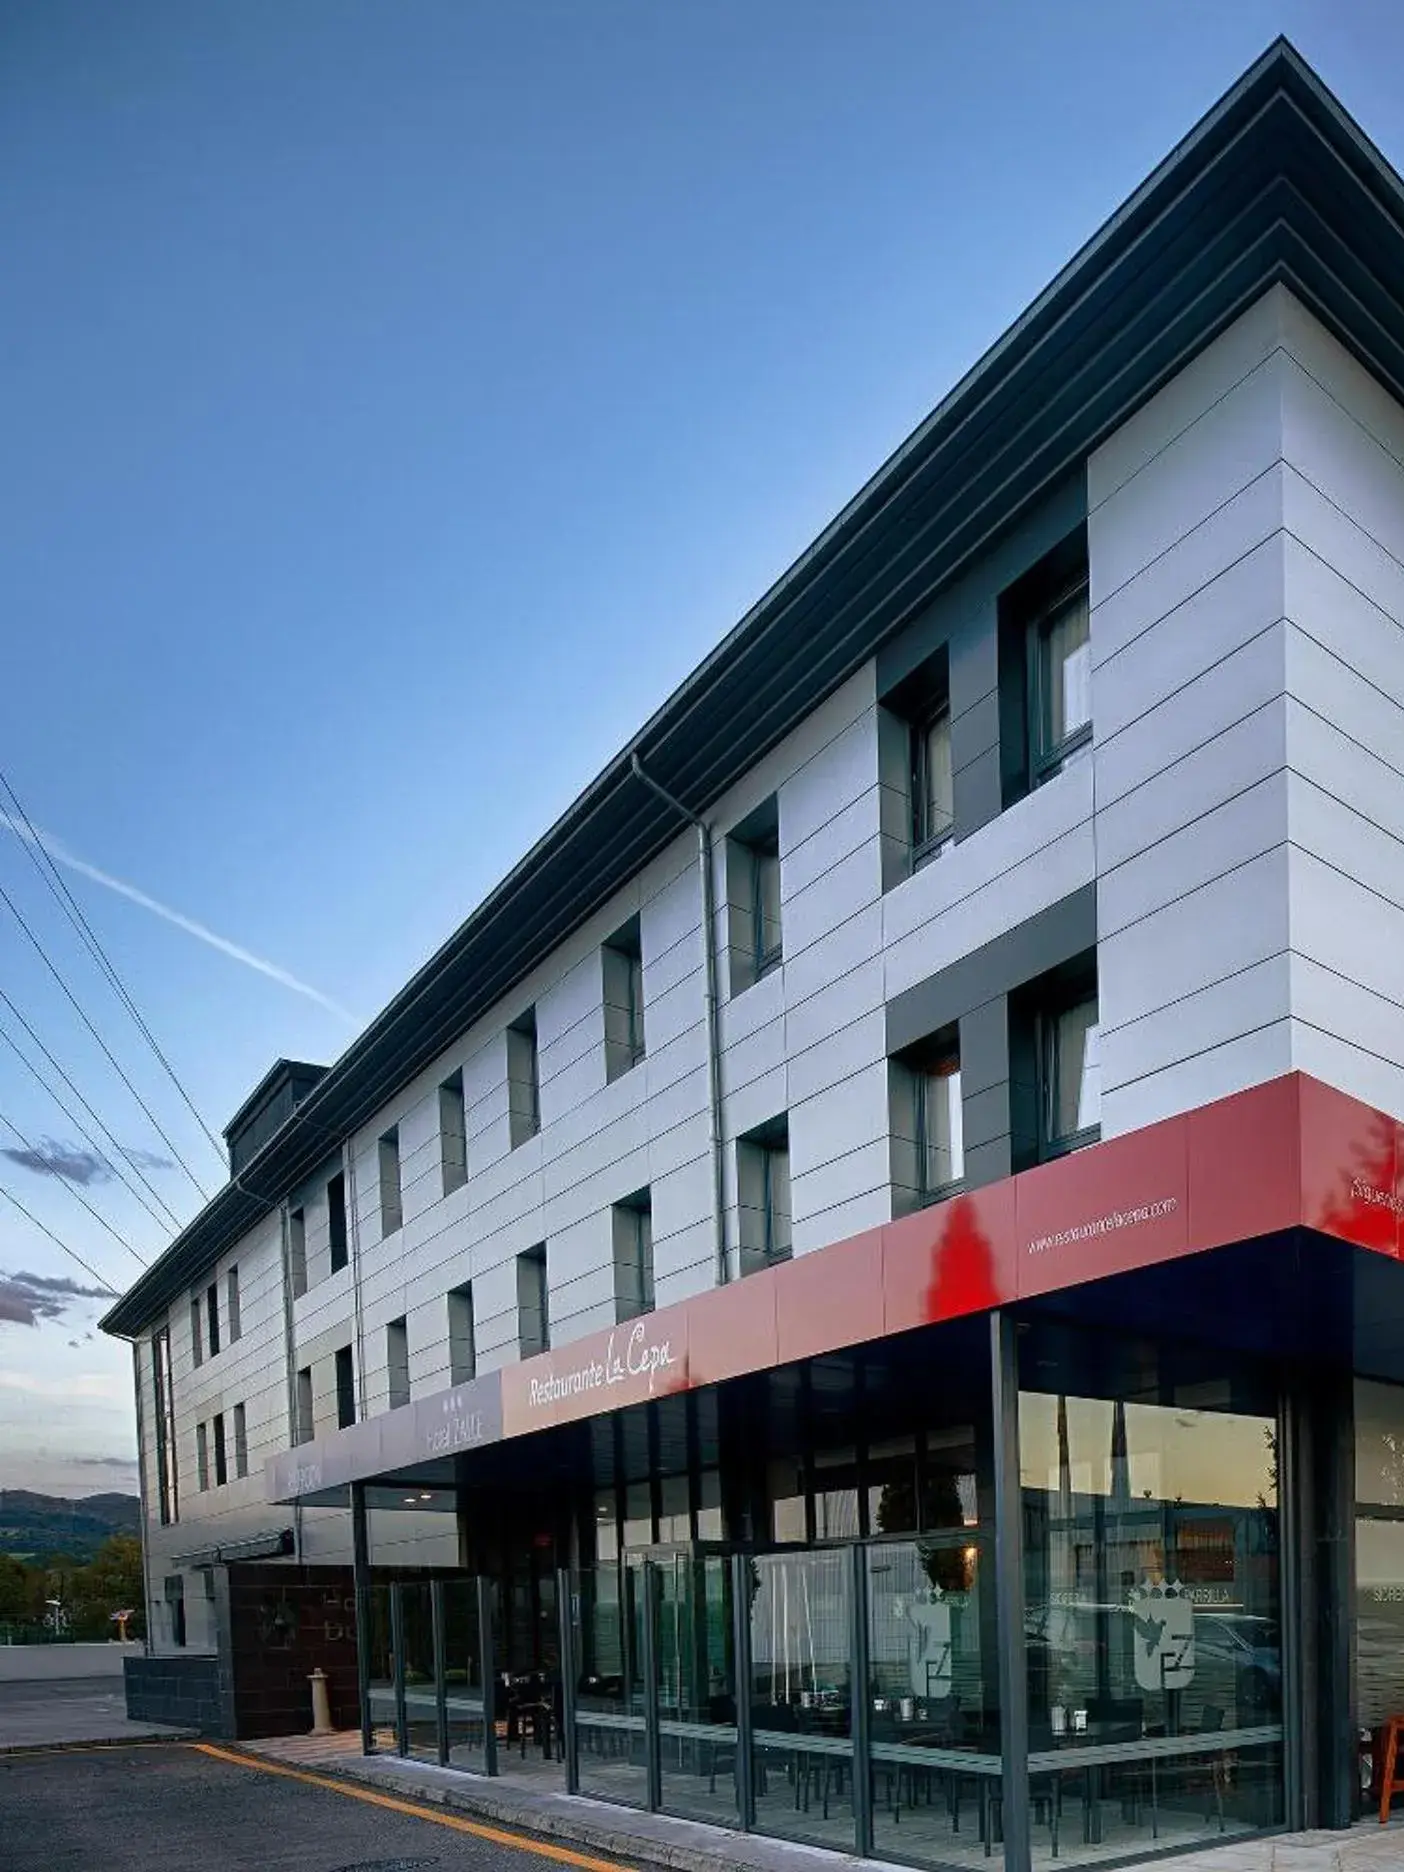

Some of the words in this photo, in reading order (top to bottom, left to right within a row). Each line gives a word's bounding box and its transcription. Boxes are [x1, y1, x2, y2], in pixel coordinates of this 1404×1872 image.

[529, 1359, 603, 1406] Restaurante
[606, 1332, 626, 1384] La
[627, 1321, 677, 1394] Cepa
